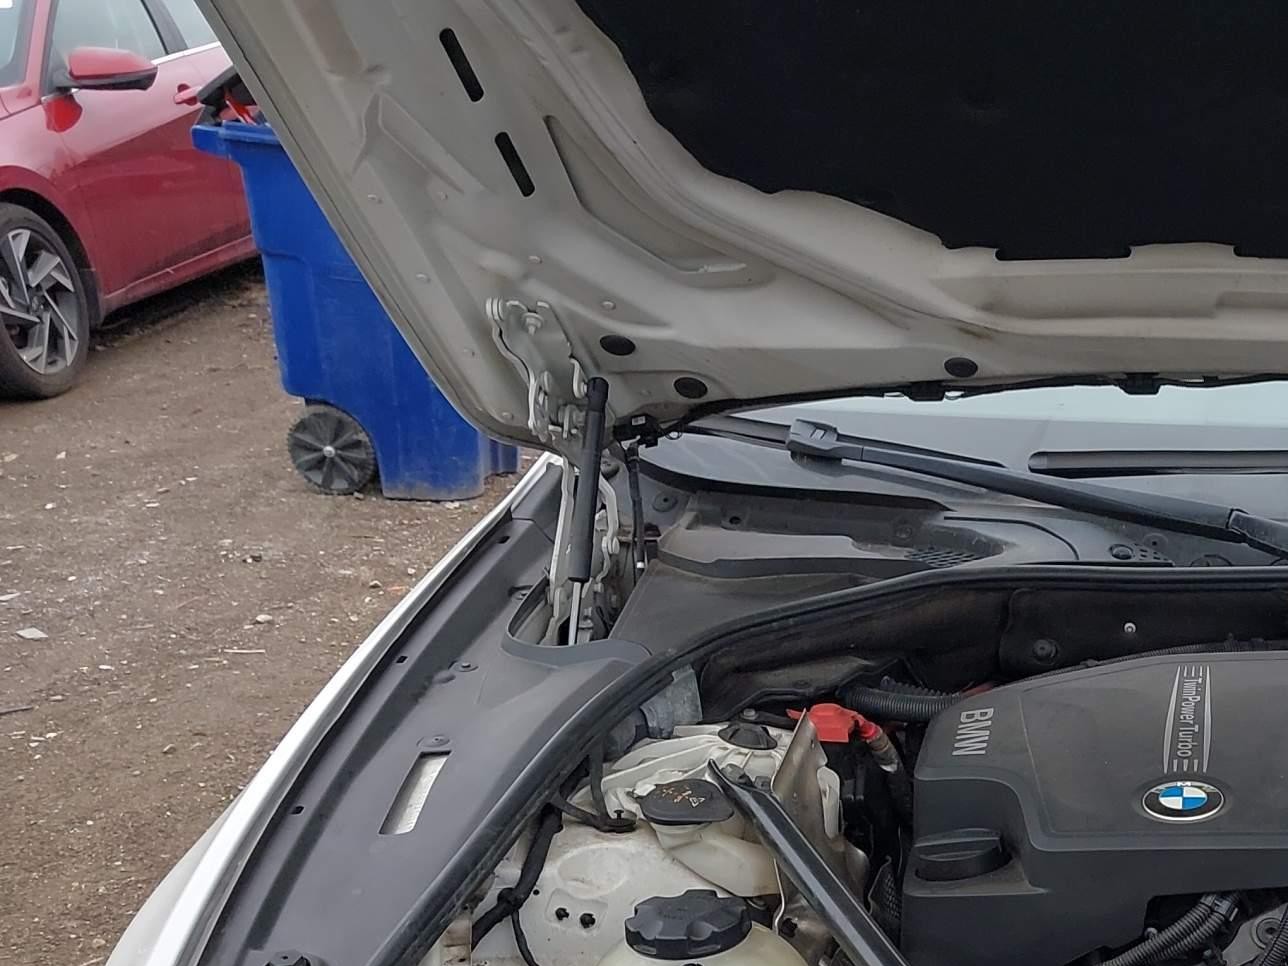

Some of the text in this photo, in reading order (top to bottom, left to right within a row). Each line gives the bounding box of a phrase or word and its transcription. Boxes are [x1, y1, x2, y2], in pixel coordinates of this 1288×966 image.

[952, 707, 994, 756] BMW
[1177, 677, 1203, 758] TwinPower Turbo
